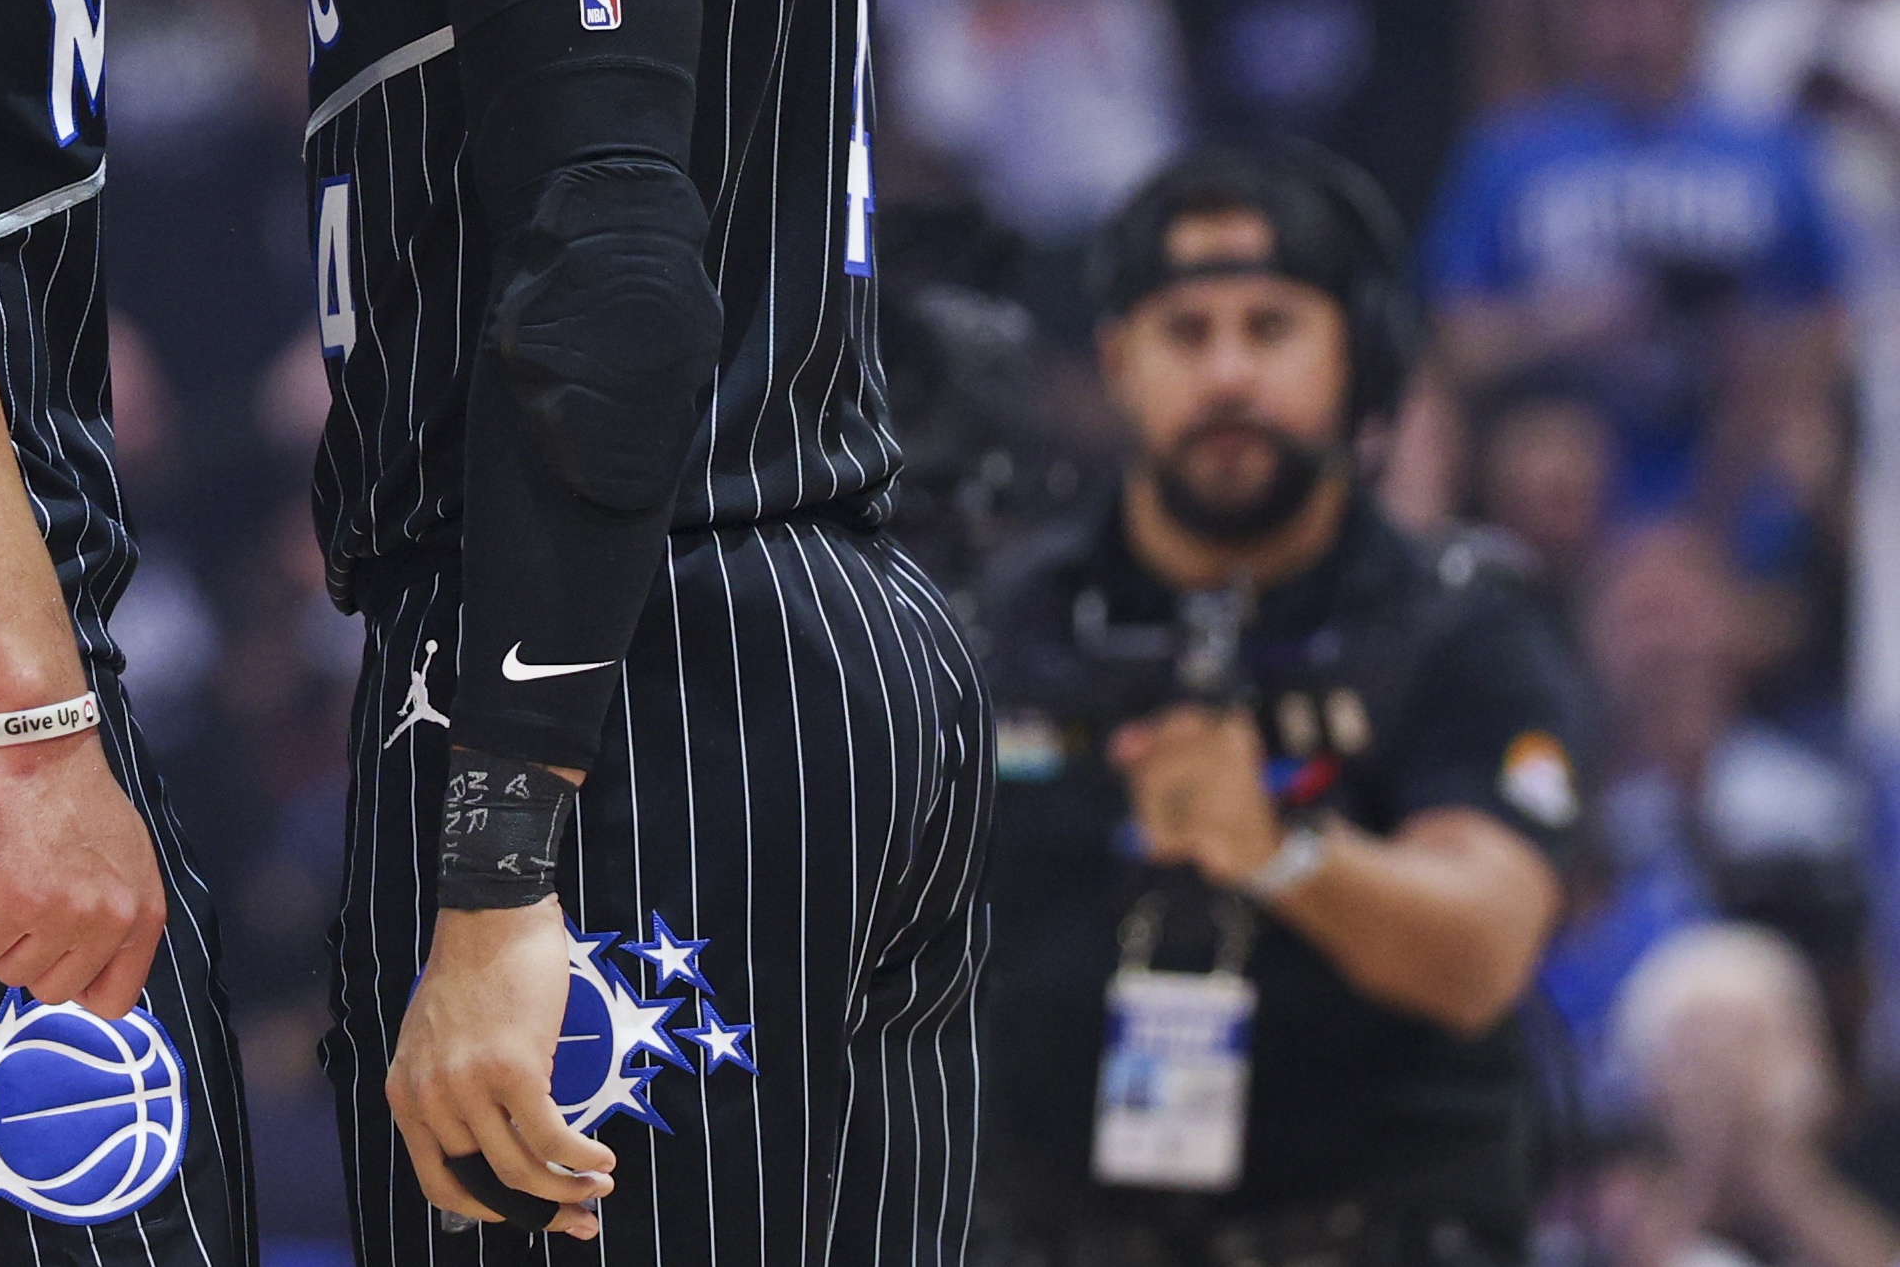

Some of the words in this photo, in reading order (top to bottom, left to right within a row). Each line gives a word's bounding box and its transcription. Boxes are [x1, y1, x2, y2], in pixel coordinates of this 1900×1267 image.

[586, 7, 607, 24] NBA
[4, 715, 53, 735] Give
[57, 707, 80, 729] Up
